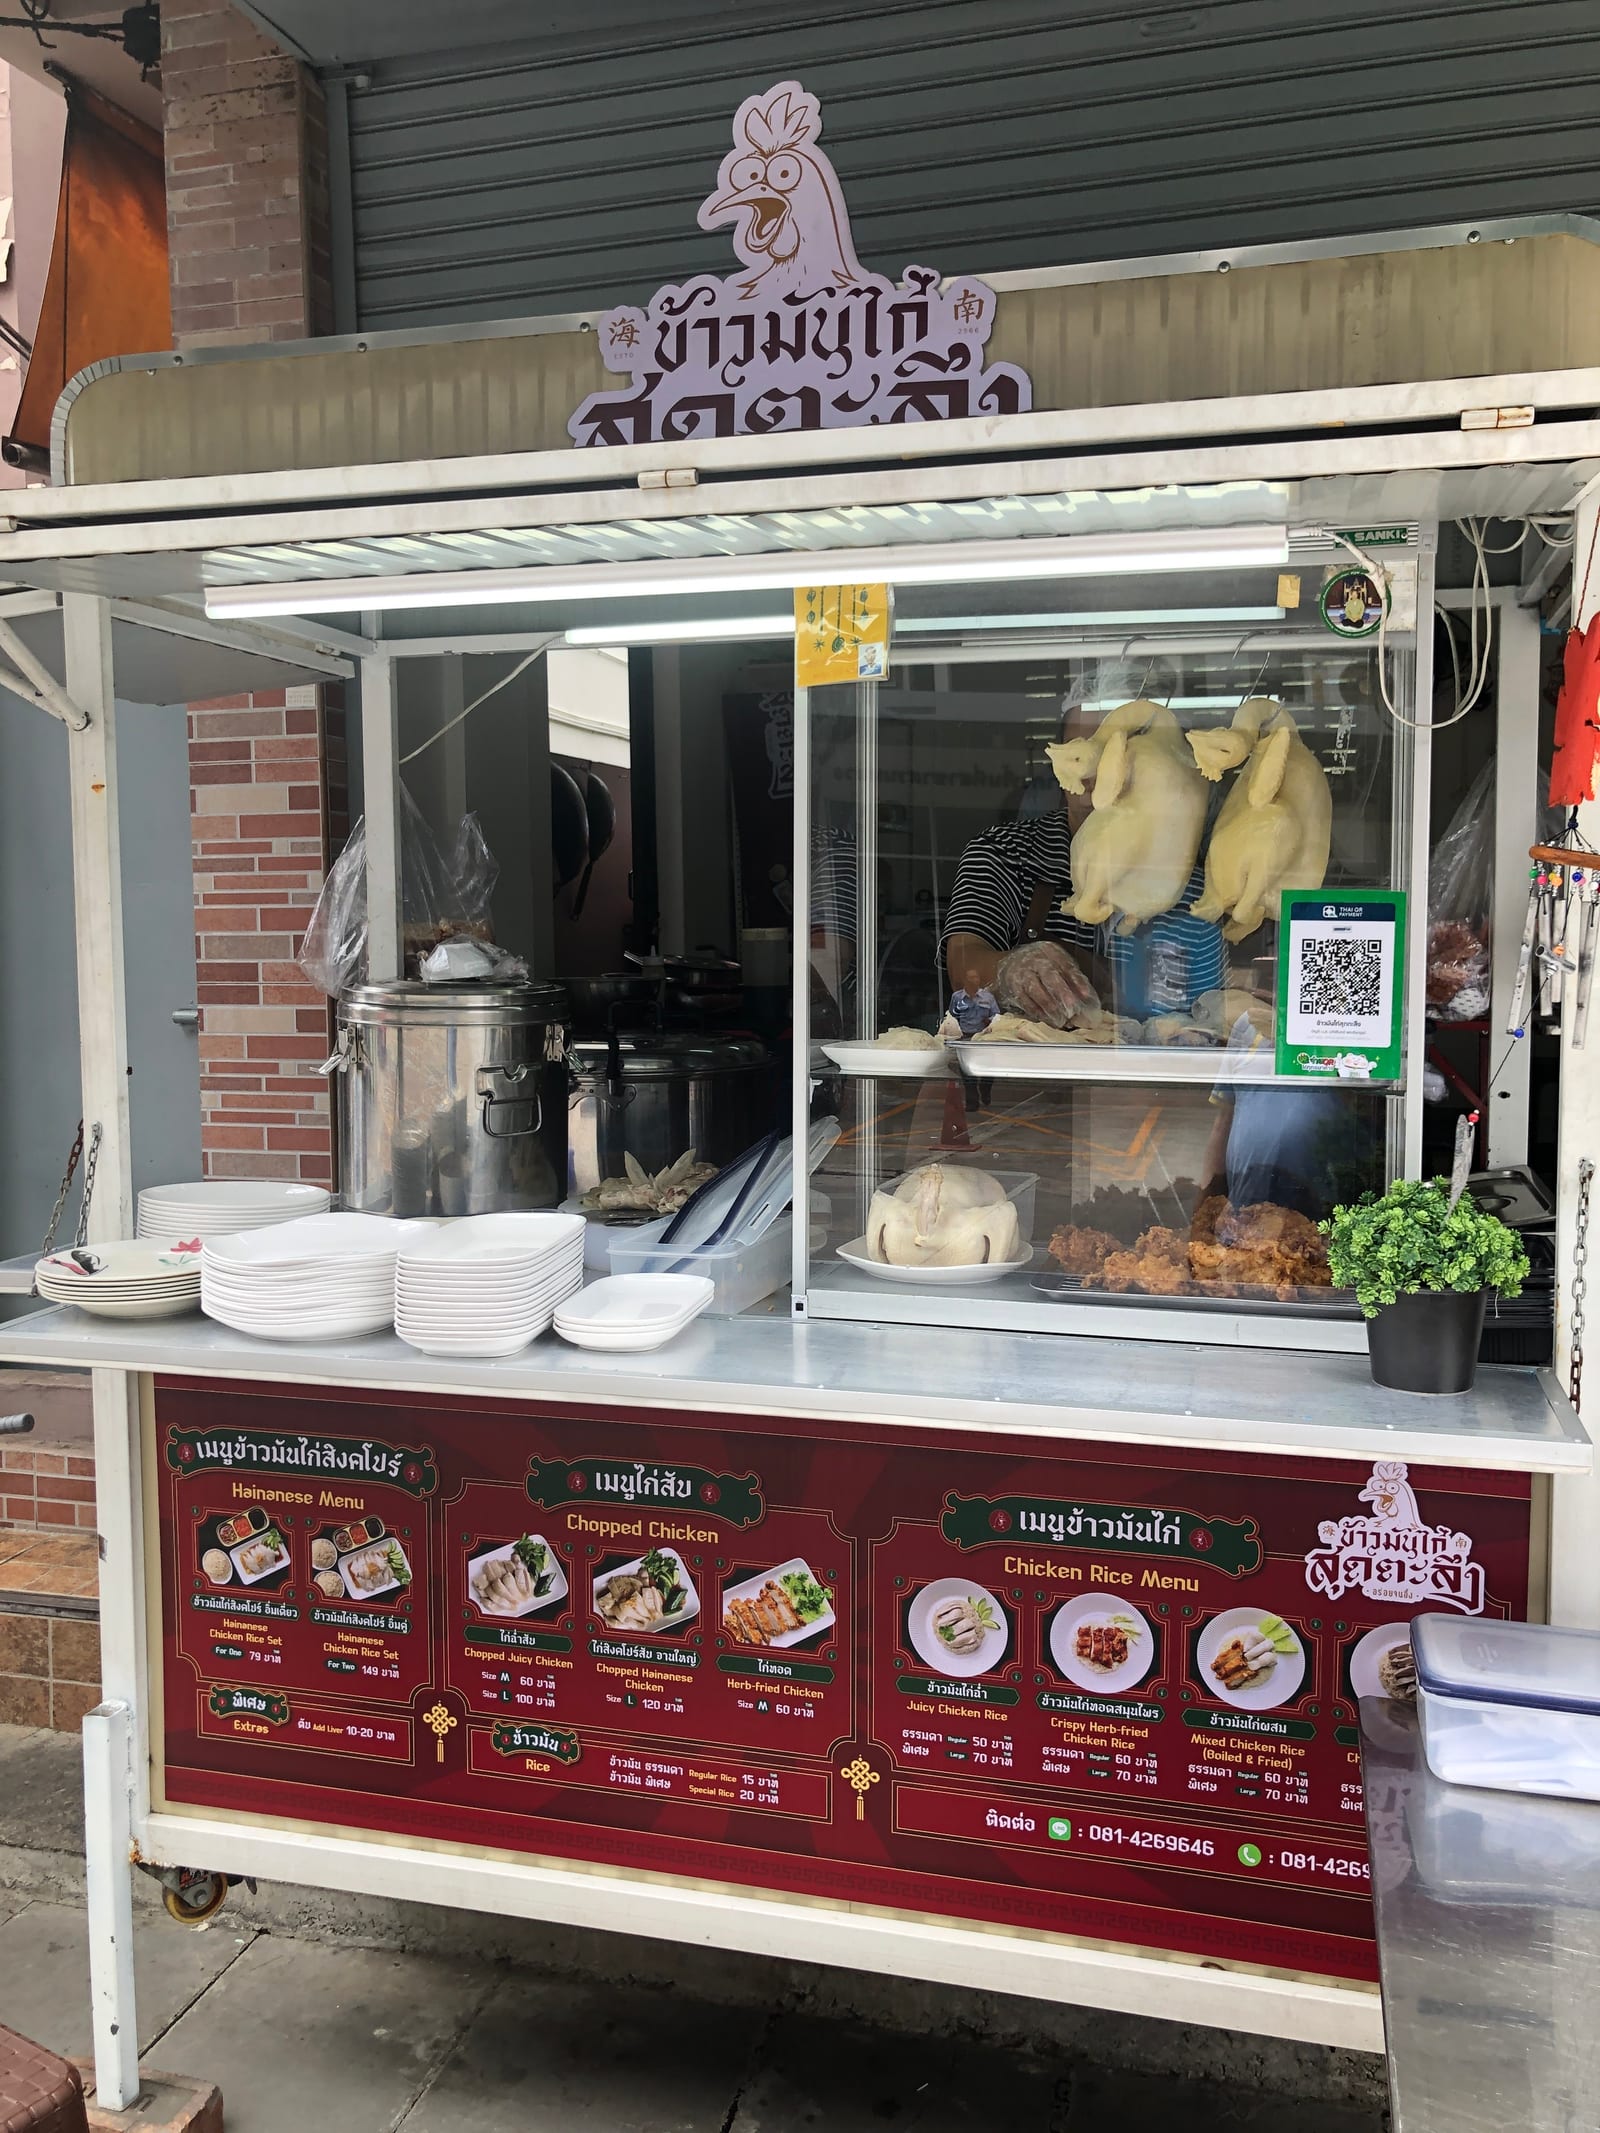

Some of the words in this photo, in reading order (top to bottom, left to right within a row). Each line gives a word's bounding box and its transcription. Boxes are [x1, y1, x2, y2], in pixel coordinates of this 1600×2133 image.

[954, 289, 984, 324] 南
[196, 1436, 403, 1477] เมนูข้าวมันไก่สิงคโปร์
[595, 1464, 692, 1500] เมนูไก่สับ
[232, 1482, 313, 1505] Hainanese
[319, 1491, 364, 1510] Menu
[566, 1514, 642, 1538] Chopped
[649, 1522, 719, 1544] Chicken
[1019, 1508, 1181, 1545] เมนูข้าวมันไก่
[1004, 1556, 1082, 1582] Chicken
[1090, 1565, 1133, 1585] Rice
[1140, 1569, 1199, 1592] Menu
[193, 1596, 262, 1613] ข้าวมันไก่สิงคโปร์
[223, 1618, 268, 1632] Hainanese
[314, 1610, 385, 1629] ข้าวมันไก่สิงคโปร์
[209, 1629, 244, 1641] Chicken
[246, 1633, 264, 1643] Rice
[267, 1635, 283, 1646] Set
[337, 1632, 384, 1645] Hainanese
[215, 1646, 227, 1655] For
[229, 1648, 242, 1657] One
[249, 1651, 261, 1661] 79
[264, 1654, 281, 1664] บาท
[323, 1642, 358, 1655] Chicken
[361, 1647, 380, 1657] Rice
[383, 1650, 399, 1660] Set
[464, 1647, 505, 1661] Chopped
[507, 1653, 533, 1666] Juicy
[536, 1656, 573, 1669] Chicken
[592, 1639, 653, 1660] ไก่สิงคโปร์สับ
[327, 1660, 340, 1669] For
[342, 1662, 356, 1671] Two
[362, 1665, 378, 1675] 149
[381, 1668, 399, 1678] บาท
[597, 1663, 638, 1677] Chopped
[641, 1668, 693, 1683] Hainanese
[757, 1658, 792, 1676] ไก่ทอด
[481, 1671, 497, 1680] Size
[500, 1672, 510, 1682] M
[520, 1676, 533, 1687] 60
[536, 1679, 555, 1689] บาท
[625, 1679, 664, 1693] Chicken
[727, 1678, 780, 1694] Herb-fried
[783, 1685, 824, 1699] Chicken
[233, 1692, 267, 1711] พิเศษ
[482, 1689, 497, 1699] Size
[502, 1691, 509, 1701] L
[515, 1694, 533, 1704] 100
[536, 1697, 555, 1707] บาท
[606, 1694, 622, 1703] Size
[628, 1695, 634, 1705] L
[642, 1699, 660, 1710] 120
[664, 1702, 684, 1713] บาท
[1041, 1693, 1159, 1720] ข้าวมันไก่ทอดสมุนไพร
[738, 1700, 754, 1709] Size
[758, 1701, 768, 1711] M
[776, 1704, 790, 1715] 60
[794, 1707, 814, 1718] บาท
[906, 1700, 935, 1714] Juicy
[938, 1704, 981, 1719] Chicken
[984, 1709, 1008, 1722] Rice
[233, 1719, 269, 1734] Extras
[313, 1724, 325, 1732] Add
[327, 1725, 343, 1734] Liver
[346, 1725, 373, 1738] 10-20
[376, 1731, 395, 1741] บาท
[1050, 1717, 1086, 1732] Crispy
[1089, 1722, 1148, 1738] Herb-fried
[1210, 1712, 1287, 1734] ข้าวมันไก่ผสม
[513, 1729, 559, 1752] ข้าวมัน
[902, 1727, 943, 1743] ธรรมดา
[972, 1736, 987, 1748] 50
[991, 1739, 1013, 1750] บาท
[1063, 1732, 1107, 1747] Chicken
[1111, 1738, 1135, 1750] Rice
[1191, 1733, 1226, 1747] Mixed
[1230, 1738, 1276, 1753] Chicken
[1280, 1744, 1305, 1756] Rice
[902, 1742, 929, 1756] พิเศษ
[950, 1751, 965, 1760] Large
[973, 1752, 987, 1764] 70
[991, 1755, 1013, 1767] บาท
[1042, 1745, 1085, 1760] ธรรมดา
[1115, 1754, 1131, 1765] 60
[1135, 1757, 1157, 1769] บาท
[1203, 1747, 1242, 1763] (Boiled
[1246, 1754, 1253, 1764] &
[1258, 1755, 1293, 1771] Fried)
[526, 1759, 550, 1772] Rice
[609, 1753, 642, 1770] ข้าวมัน
[645, 1761, 684, 1776] ธรรมดา
[689, 1769, 717, 1782] Regular
[720, 1772, 737, 1782] Rice
[742, 1774, 754, 1785] 15
[758, 1777, 779, 1788] บาท
[1042, 1760, 1070, 1774] พิเศษ
[1092, 1768, 1107, 1777] Large
[1115, 1769, 1131, 1781] 70
[1135, 1773, 1157, 1785] บาท
[1188, 1763, 1232, 1778] ธรรมดา
[1237, 1771, 1259, 1780] Regular
[1264, 1772, 1281, 1783] 60
[1285, 1775, 1309, 1787] บาท
[609, 1770, 642, 1786] ข้าวมัน
[645, 1775, 671, 1788] พิเศษ
[688, 1785, 716, 1798] Special
[719, 1788, 735, 1798] Rice
[740, 1789, 754, 1801] 20
[758, 1792, 779, 1804] บาท
[1187, 1778, 1217, 1792] พิเศษ
[1240, 1787, 1256, 1796] Large
[1265, 1789, 1280, 1800] 70
[1285, 1792, 1308, 1805] บาท
[1340, 1797, 1364, 1812] พิเศ
[986, 1809, 1036, 1832] ติดต่อ
[1089, 1825, 1215, 1856] 081-4269646
[1280, 1852, 1371, 1878] 081-4269
